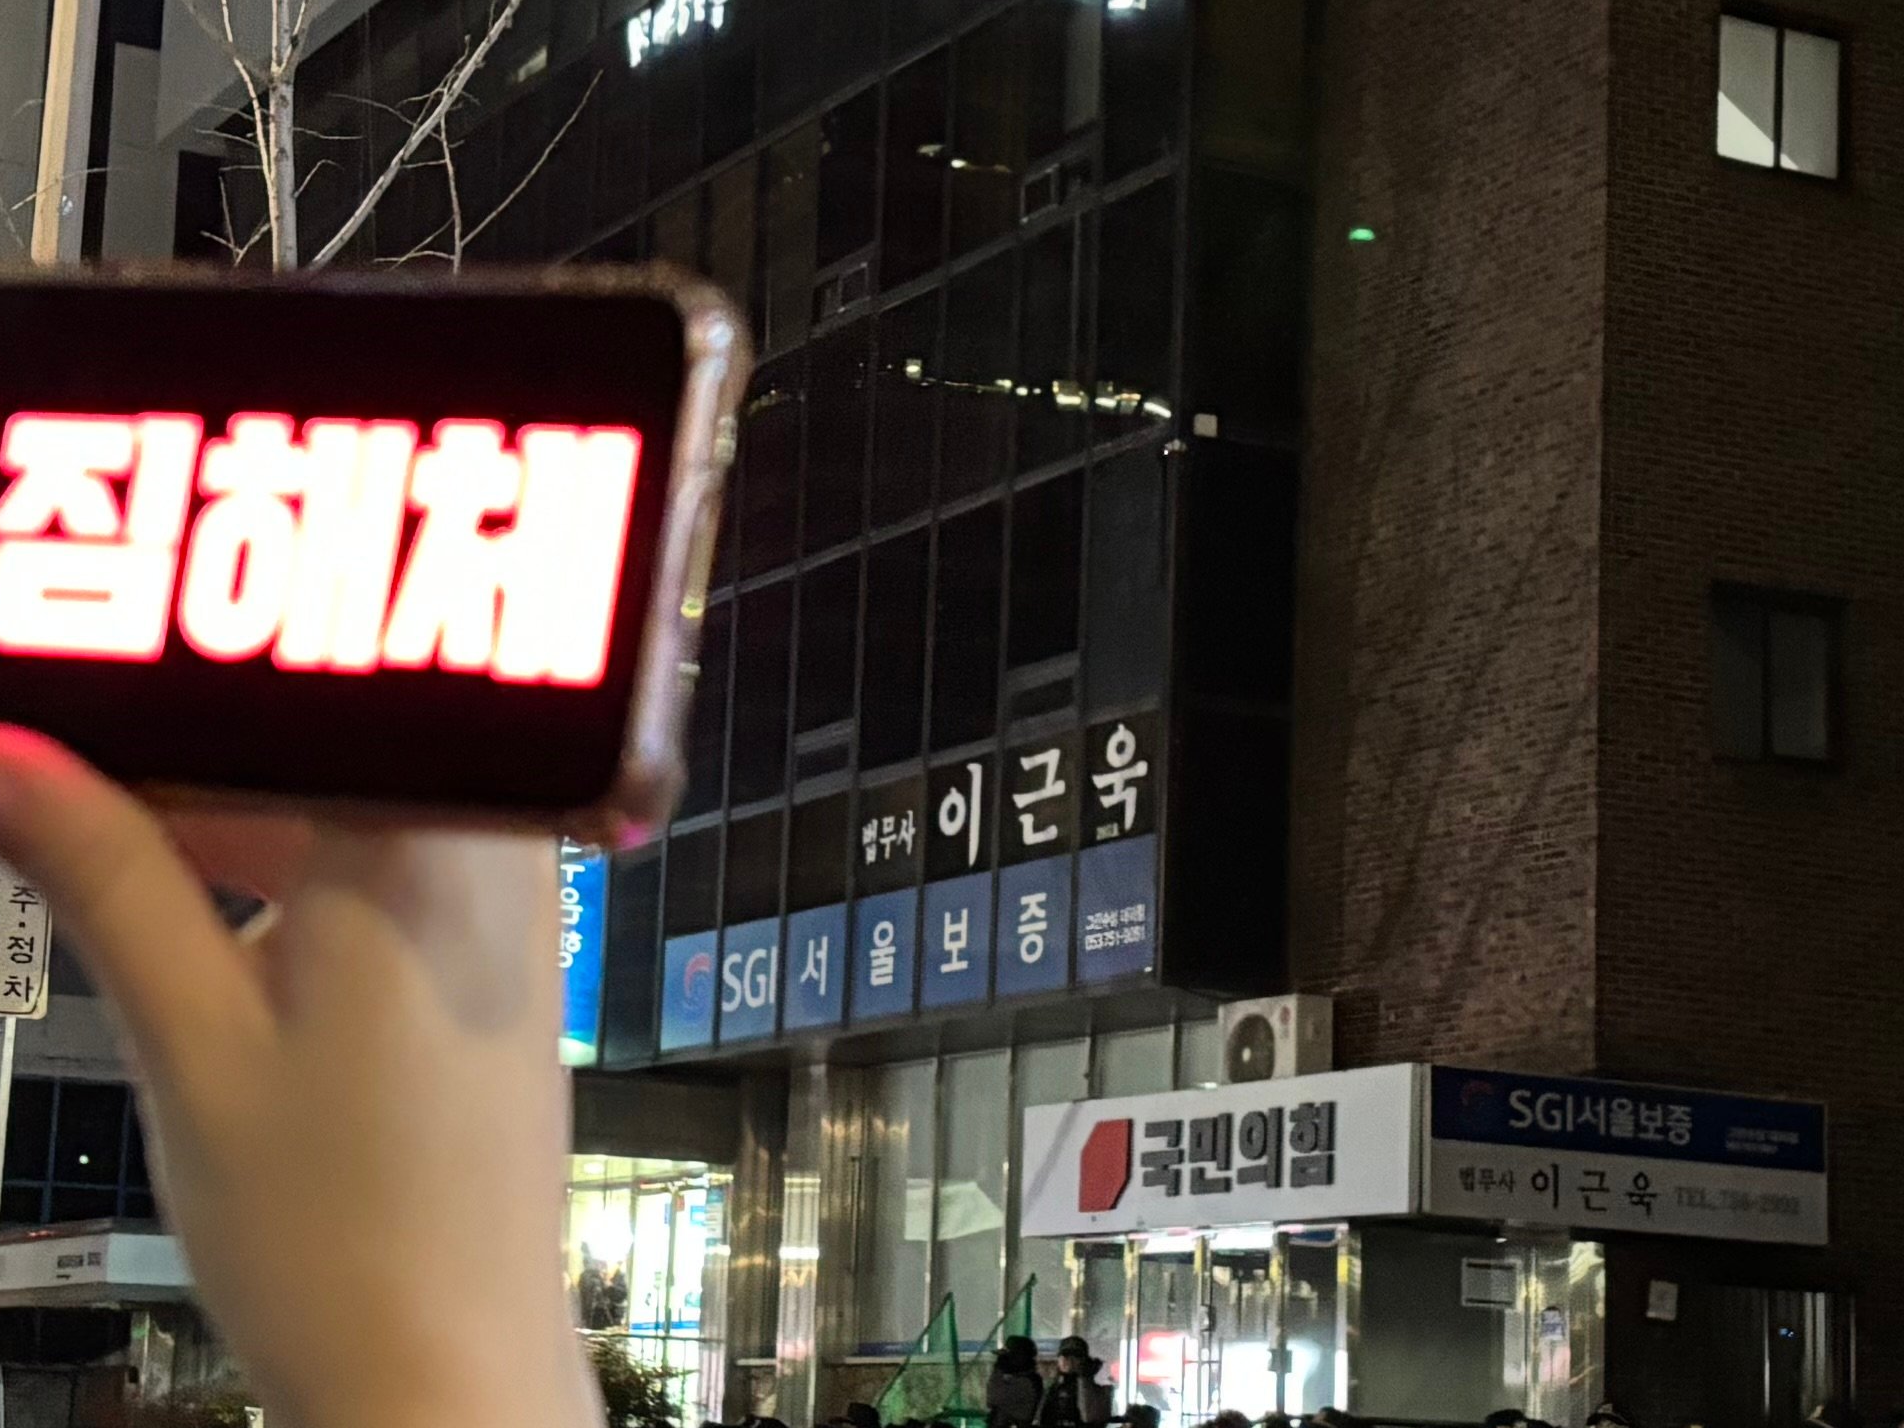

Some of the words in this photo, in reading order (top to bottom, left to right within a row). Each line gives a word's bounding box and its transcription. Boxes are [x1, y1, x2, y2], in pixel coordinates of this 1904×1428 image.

[862, 810, 915, 865] 법무사
[939, 724, 1148, 867] 이근욱
[1141, 1100, 1338, 1197] 국민의힘
[1508, 1089, 1693, 1146] SGI서울보증
[1458, 1166, 1517, 1194] 법무사
[1530, 1162, 1660, 1216] 이근욱
